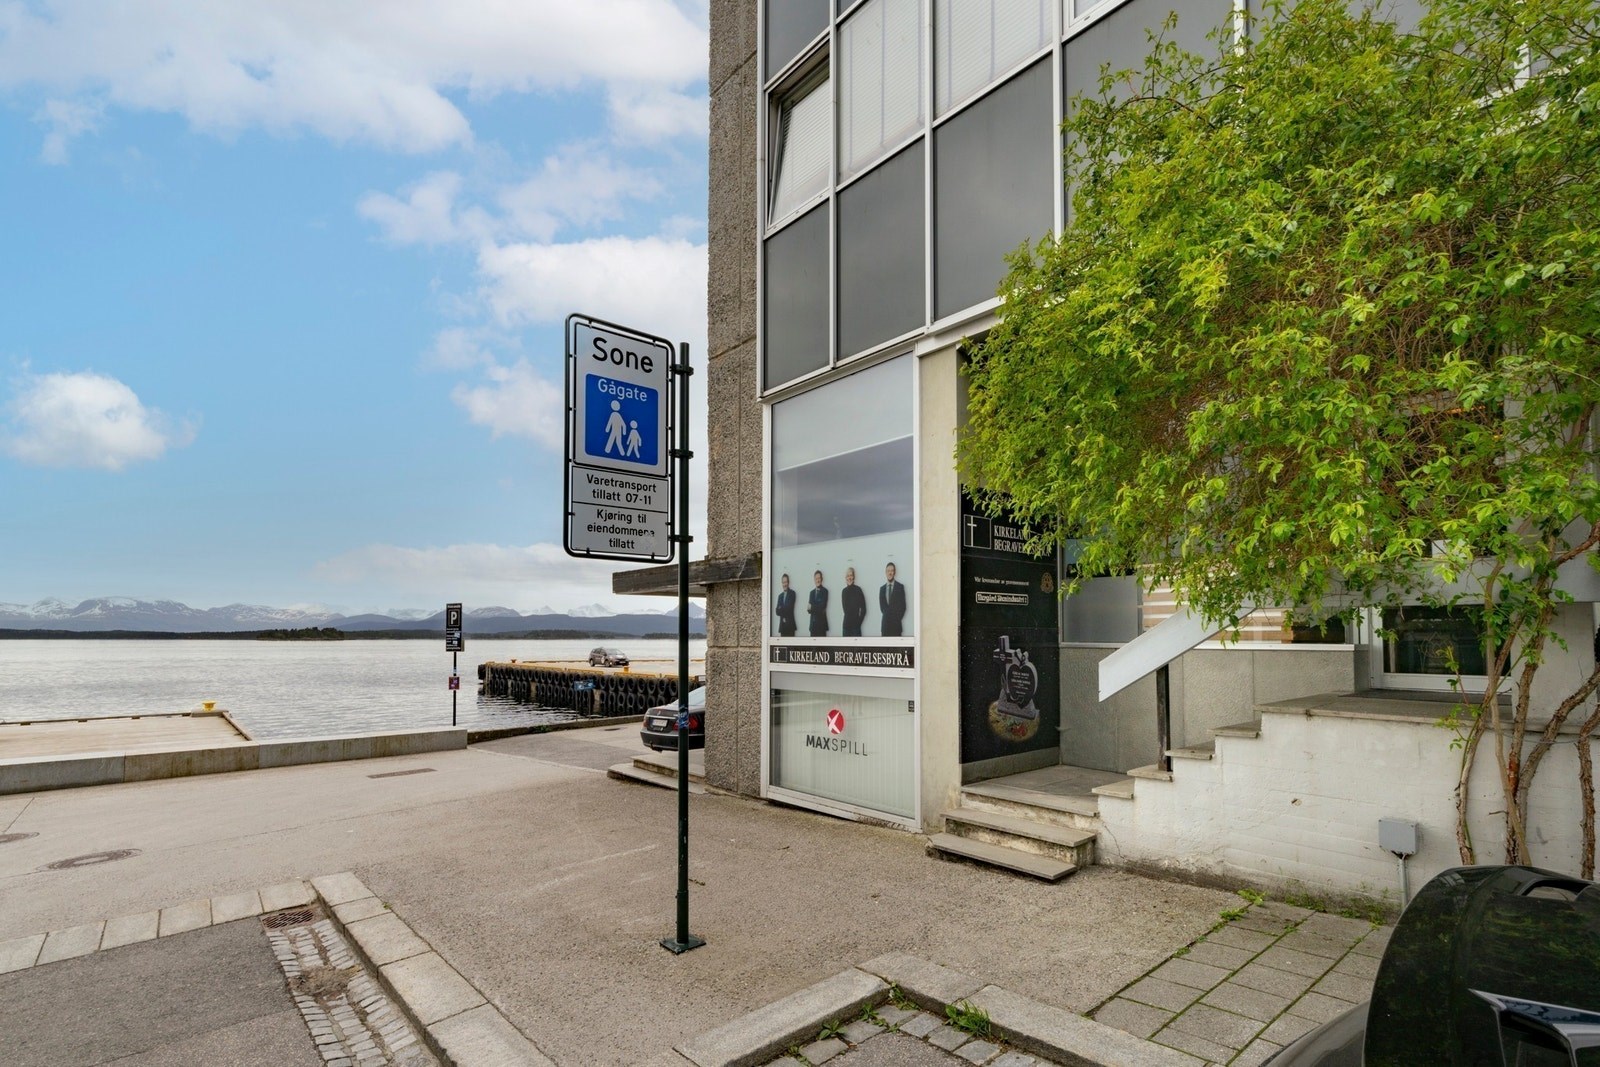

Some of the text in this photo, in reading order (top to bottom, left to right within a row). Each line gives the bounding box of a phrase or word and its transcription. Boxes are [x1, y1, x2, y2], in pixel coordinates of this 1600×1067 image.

[592, 336, 654, 374] Sone
[597, 378, 648, 402] Gågate
[586, 473, 657, 493] Varetransport
[592, 489, 652, 505] tillatt 07-11
[596, 508, 647, 524] Kjøring til
[608, 537, 635, 550] tillatt
[450, 611, 457, 625] P
[789, 649, 910, 667] KIRKELAND BEGRAVELSESBYRÅ
[805, 734, 869, 757] MAXSPILL
